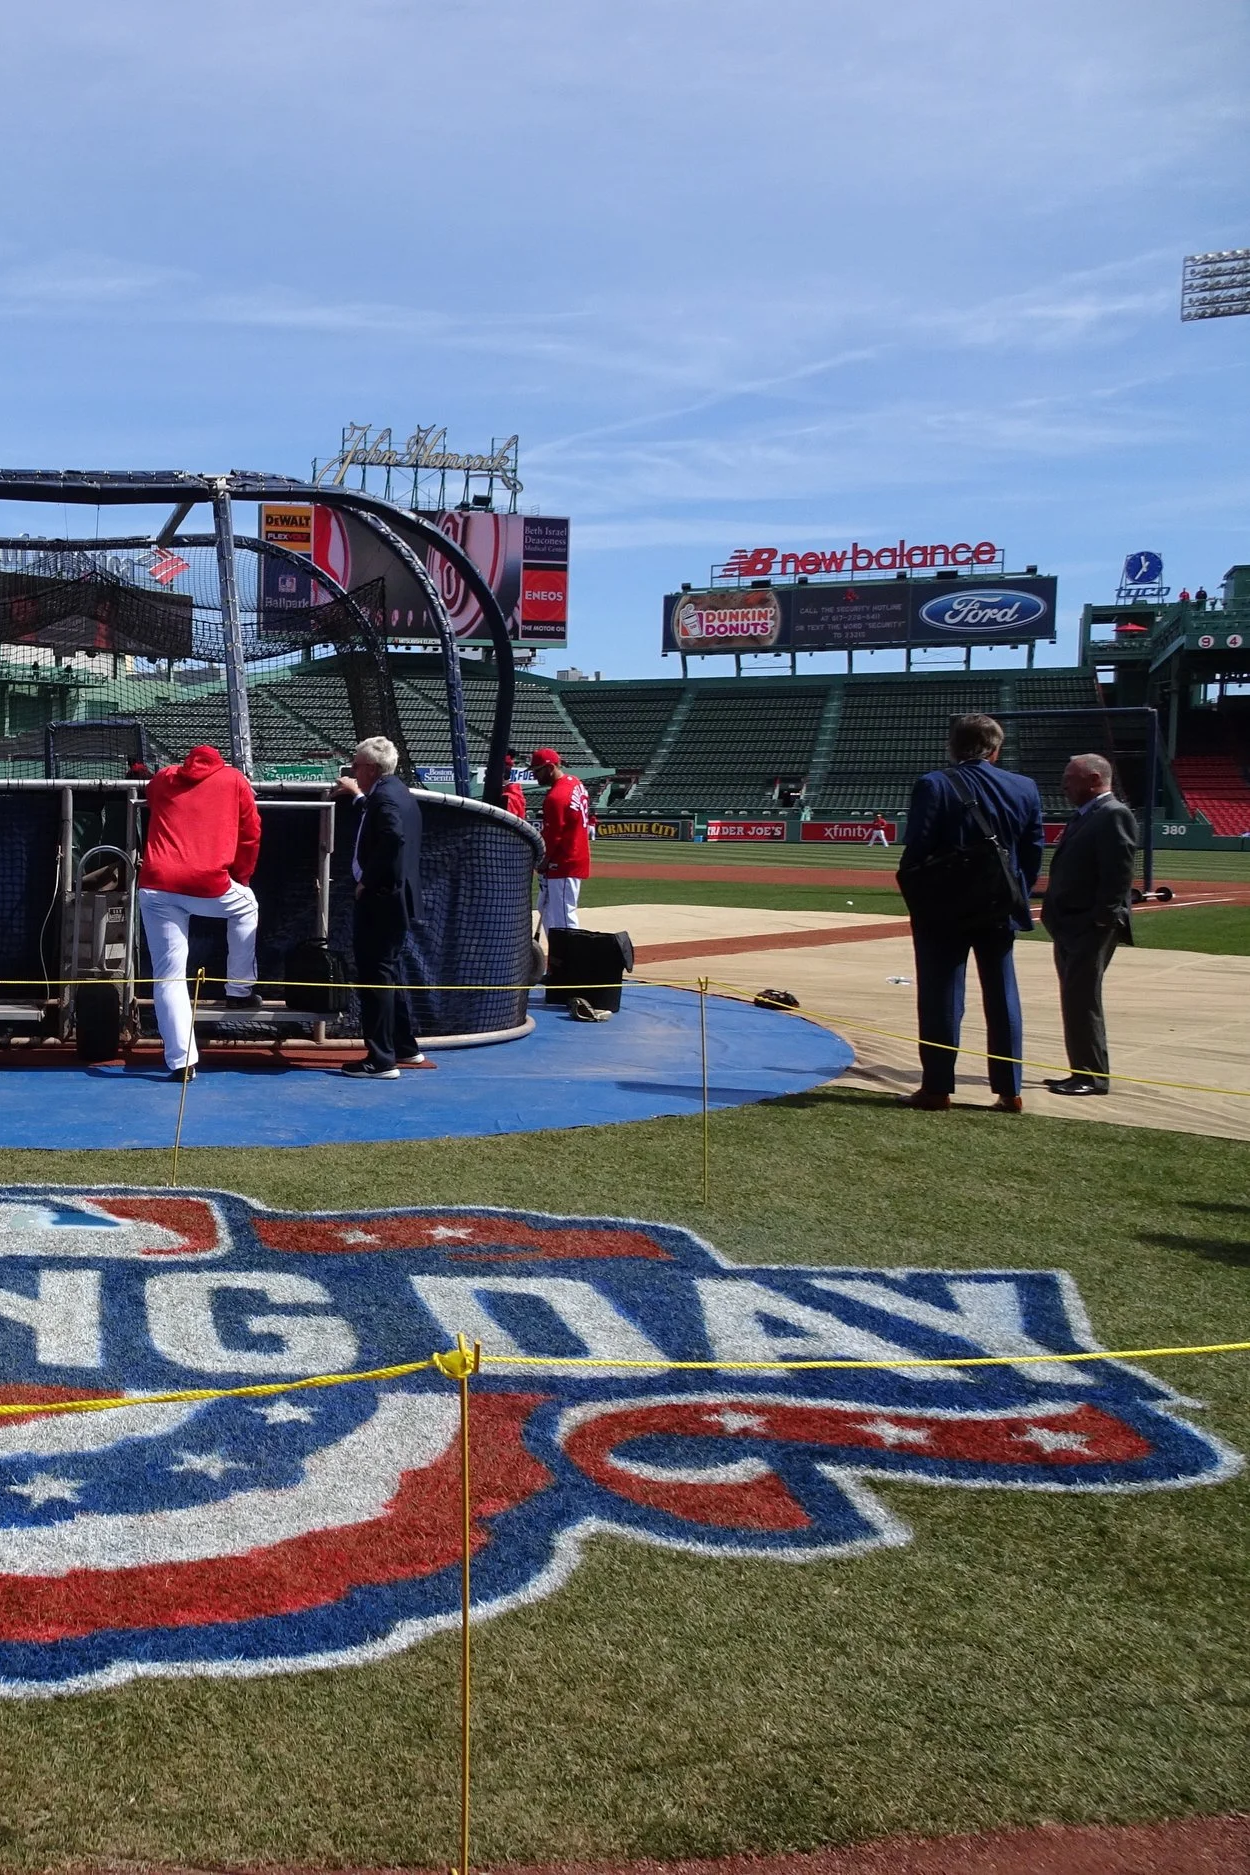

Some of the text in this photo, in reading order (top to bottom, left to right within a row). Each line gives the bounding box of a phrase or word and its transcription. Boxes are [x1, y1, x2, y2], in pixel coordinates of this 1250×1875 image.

[315, 422, 524, 493] John Hancock
[524, 526, 567, 537] Beth Israel
[524, 535, 567, 546] Deaconess
[524, 590, 564, 602] ENEOS
[265, 597, 309, 610] Ballpark
[705, 608, 775, 623] DUNKIN'
[945, 597, 1022, 625] Ford
[705, 621, 770, 636] DONUTS
[1201, 637, 1210, 647] 9
[1229, 637, 1238, 647] 4
[597, 822, 678, 837] GRANITE CITY
[747, 825, 783, 836] JOE'S
[823, 824, 873, 840] xfinity
[1162, 825, 1186, 835] 380
[410, 1273, 1100, 1384] DAY
